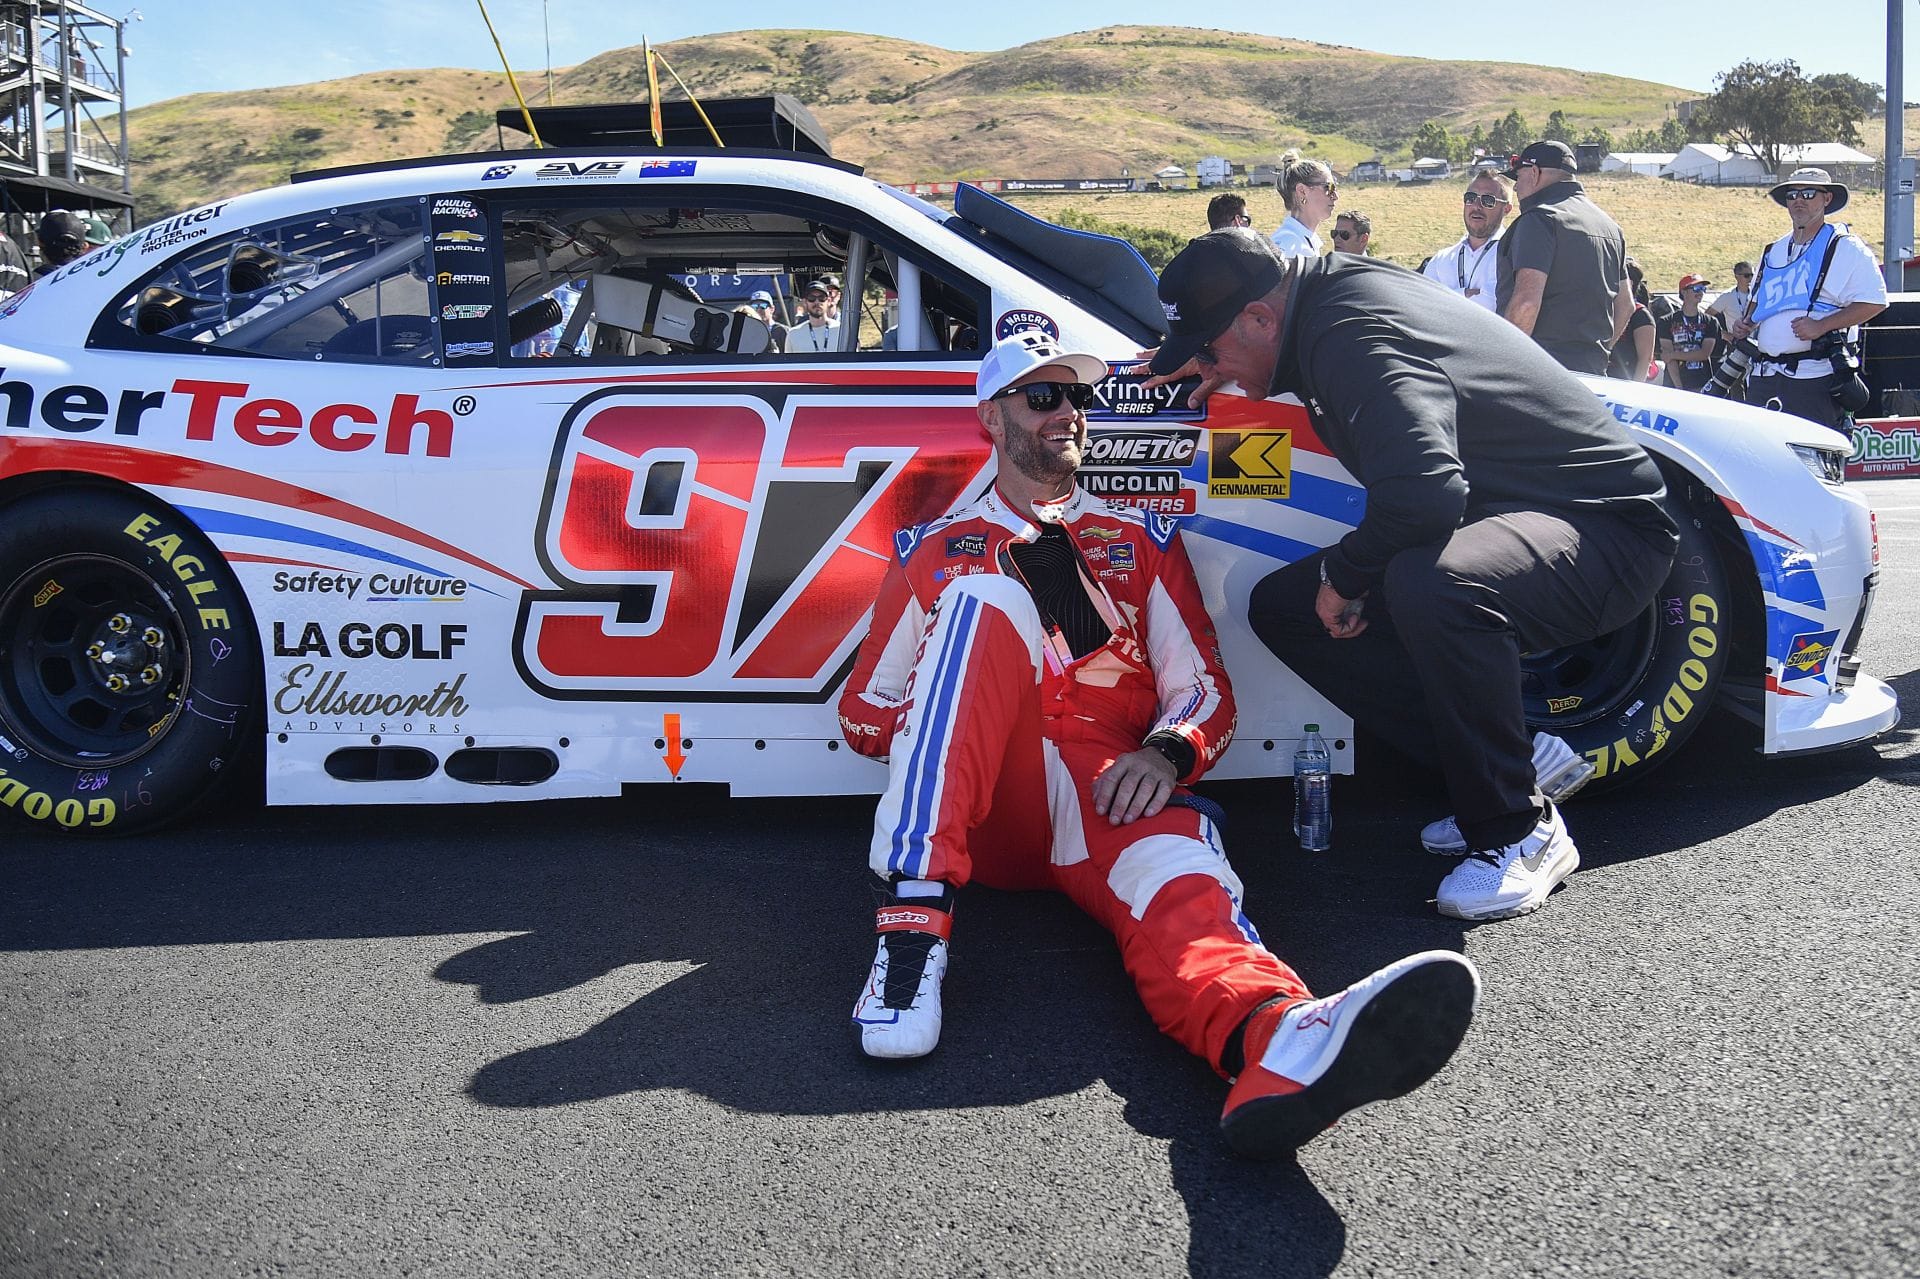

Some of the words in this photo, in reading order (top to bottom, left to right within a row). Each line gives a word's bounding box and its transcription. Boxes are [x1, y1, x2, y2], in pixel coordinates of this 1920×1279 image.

[537, 161, 628, 176] SVG
[432, 207, 470, 216] RACING
[435, 199, 472, 208] KAULIG
[140, 227, 208, 255] PROTECTION
[142, 229, 183, 248] GUTTER
[434, 245, 487, 253] CHEVROLET
[1005, 313, 1049, 329] NASCAR
[1115, 403, 1155, 414] SERIES
[1863, 464, 1881, 472] AUTO
[1882, 463, 1905, 471] PARTS
[514, 388, 996, 700] 97
[124, 512, 230, 630] EAGLE
[273, 572, 362, 600] Safety
[369, 574, 467, 596] Culture
[273, 622, 332, 657] LA
[338, 622, 467, 659] GOLF
[1787, 647, 1832, 666] SUNOCO
[274, 663, 469, 717] Ellsworth
[1553, 699, 1576, 710] AERO
[284, 721, 461, 733] ADVISORS
